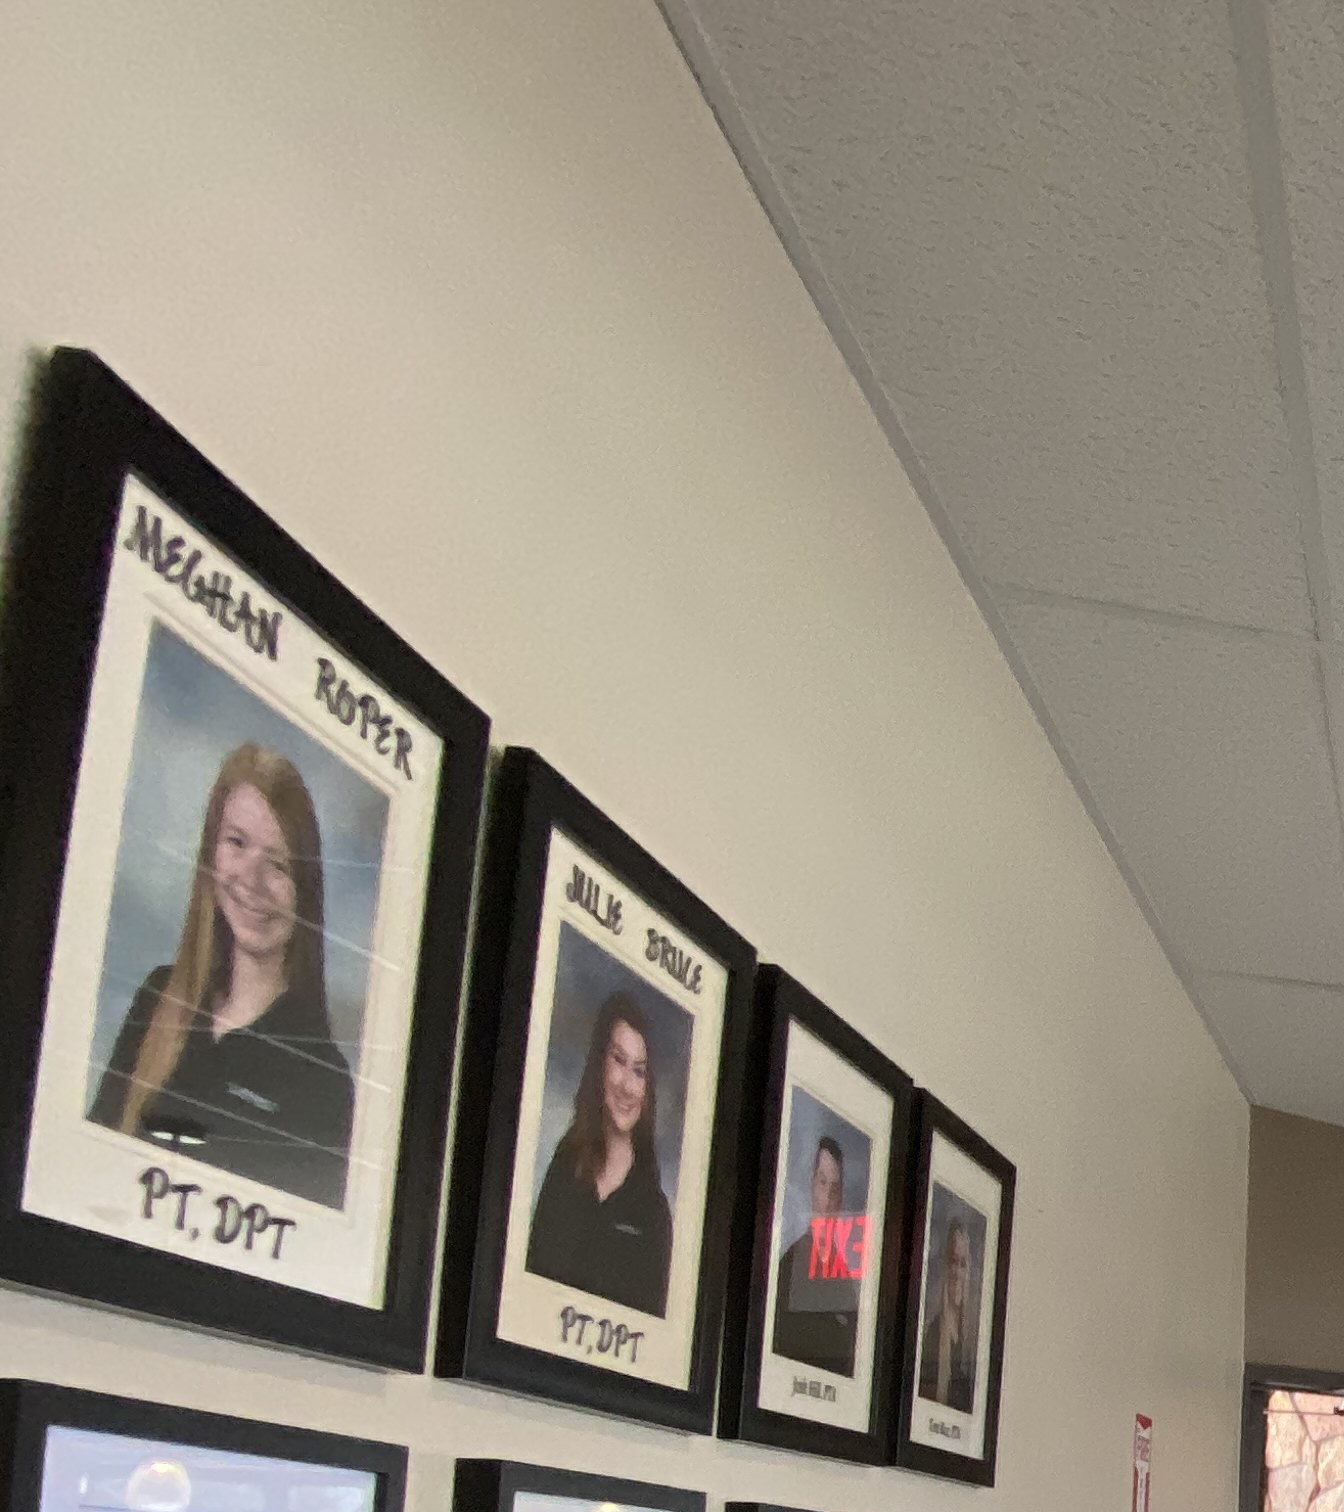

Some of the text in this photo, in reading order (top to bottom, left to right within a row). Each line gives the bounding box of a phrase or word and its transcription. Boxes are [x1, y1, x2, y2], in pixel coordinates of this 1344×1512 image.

[123, 504, 413, 780] MEGHAN ROPER
[214, 1195, 297, 1260] DPT
